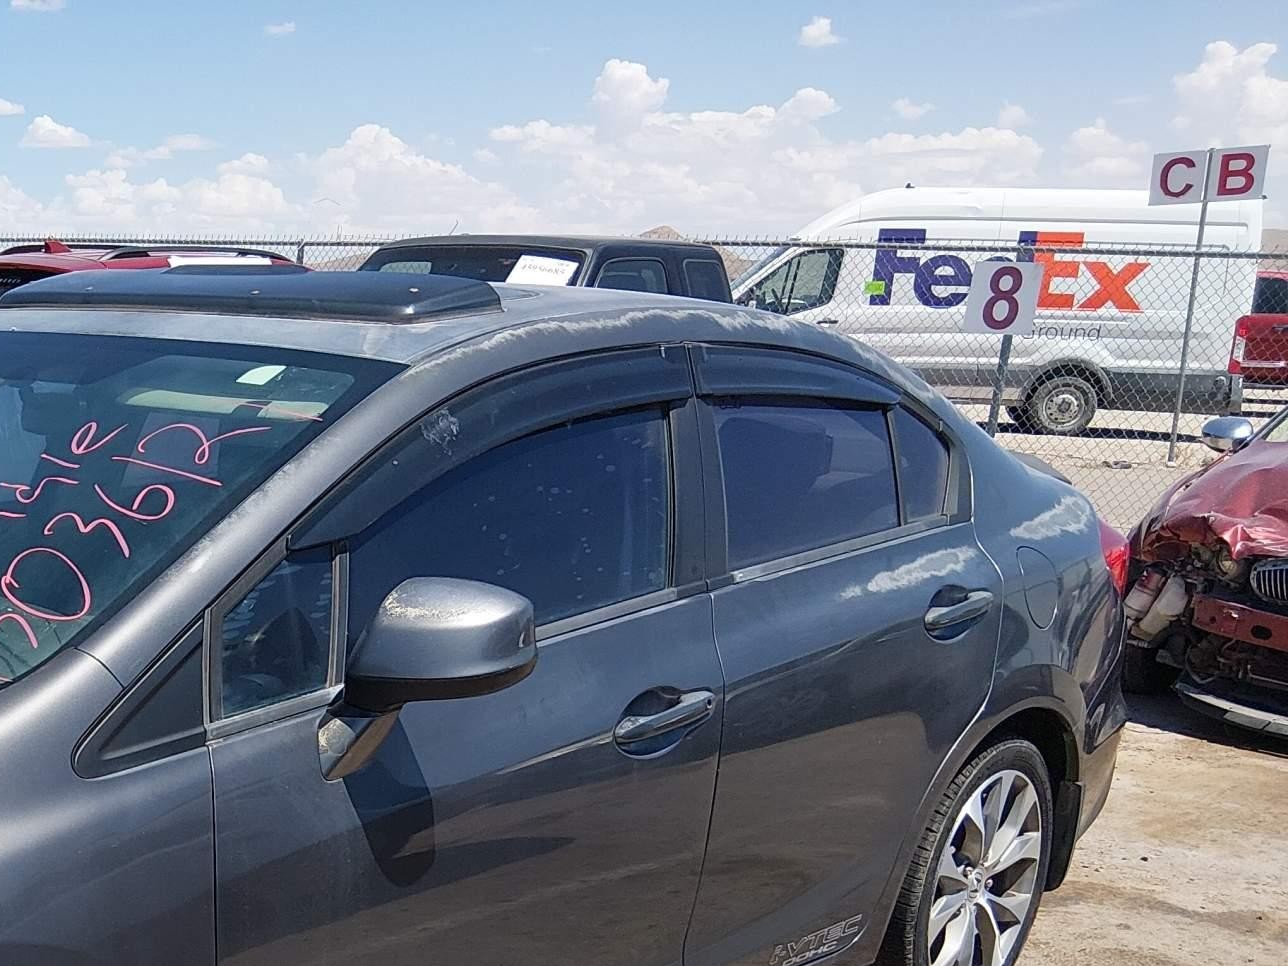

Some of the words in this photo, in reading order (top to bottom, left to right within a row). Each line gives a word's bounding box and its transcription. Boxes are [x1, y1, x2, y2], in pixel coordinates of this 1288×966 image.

[1159, 156, 1196, 198] C
[1216, 152, 1256, 196] B
[869, 229, 1151, 313] FeEx
[982, 265, 1023, 331] 8
